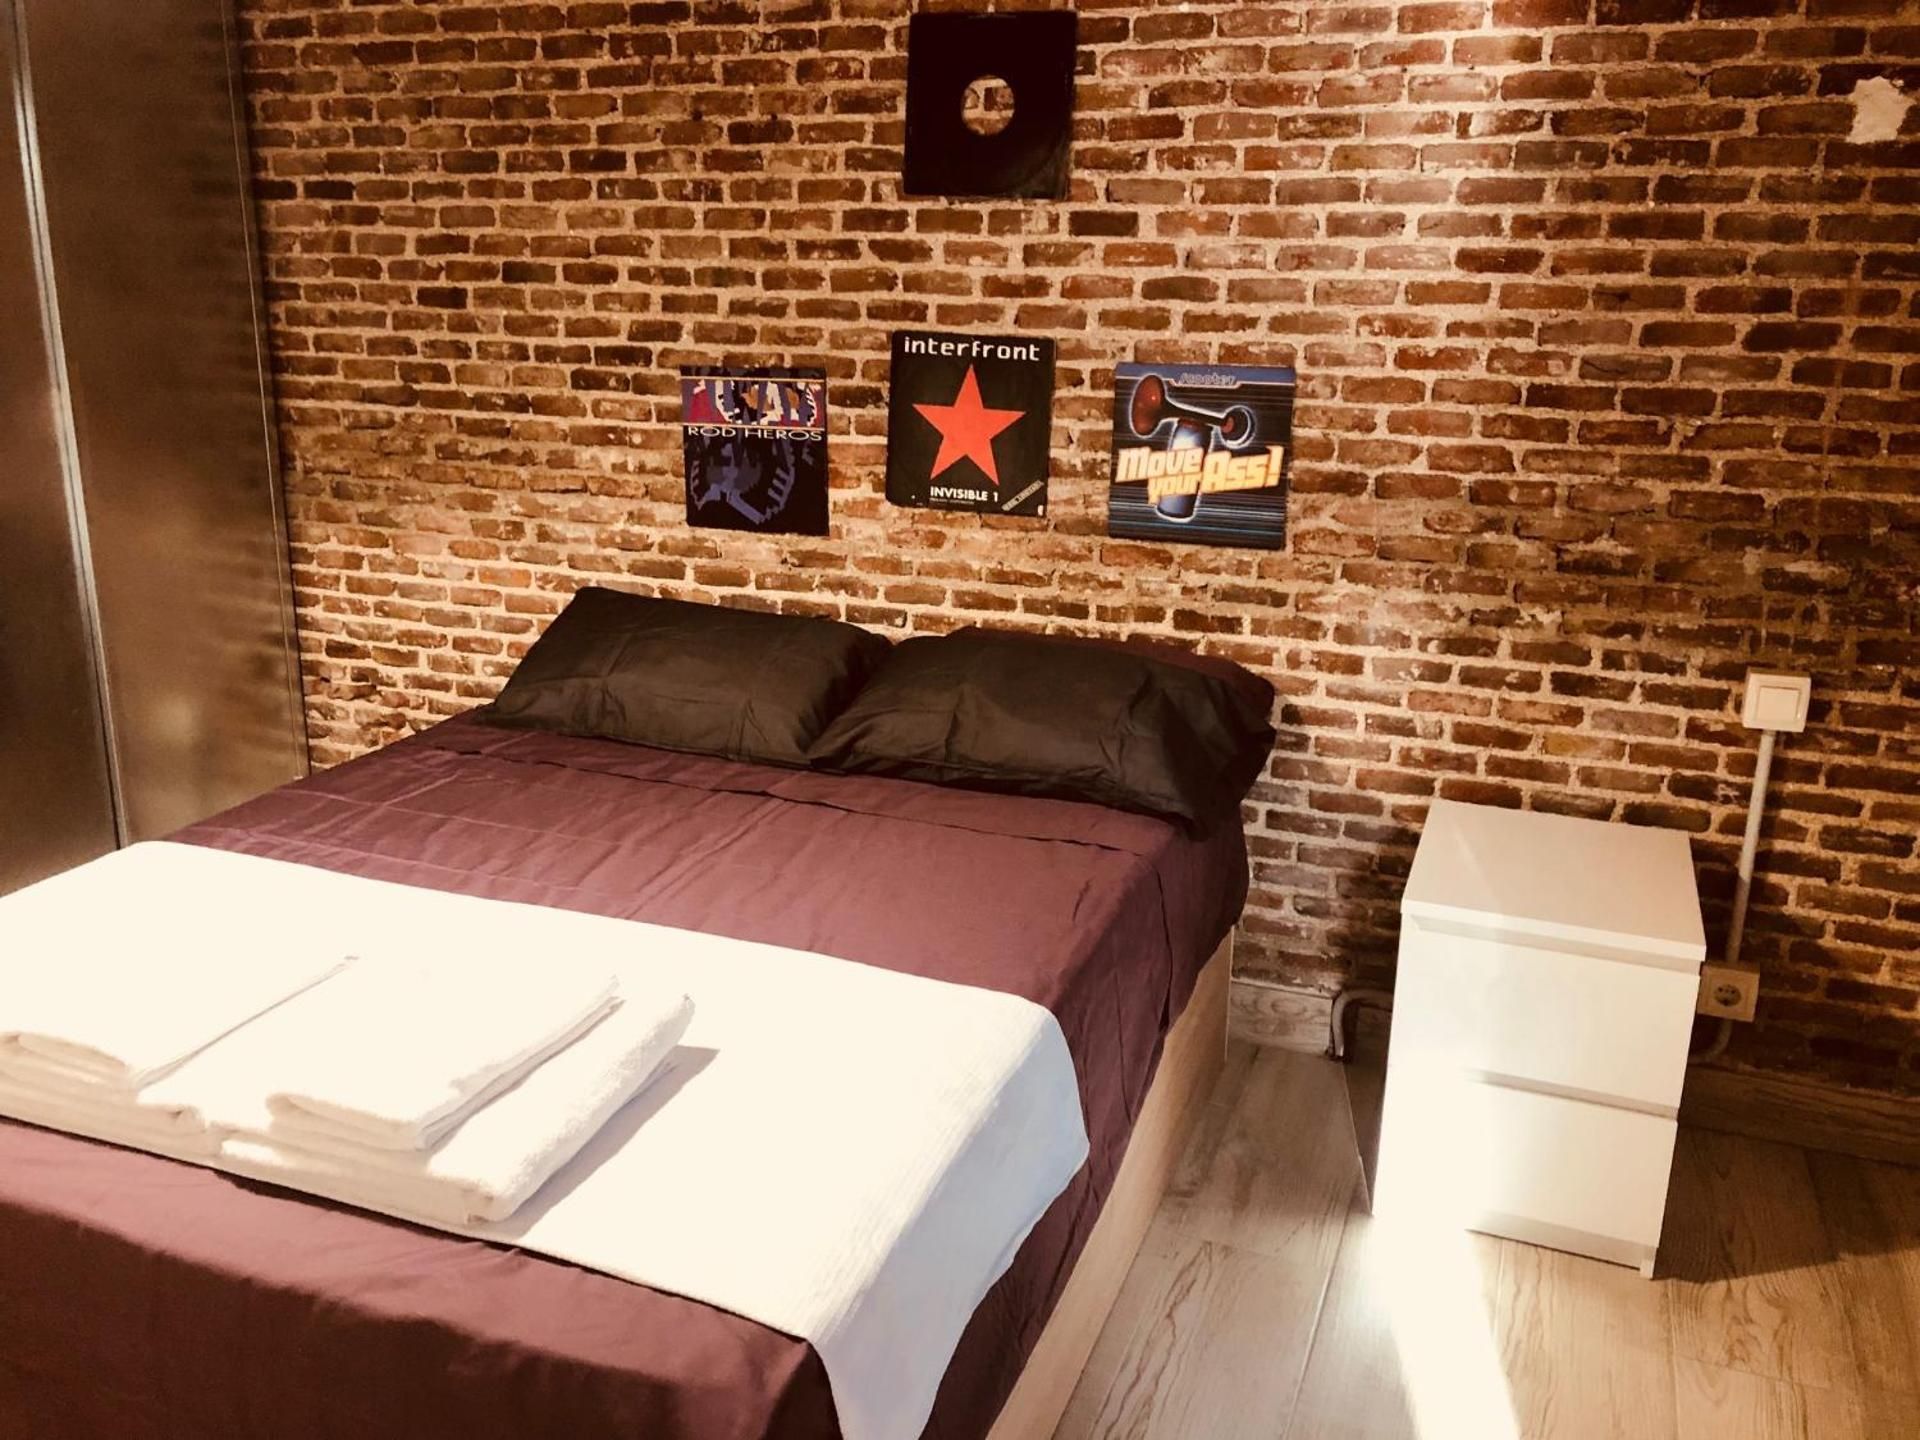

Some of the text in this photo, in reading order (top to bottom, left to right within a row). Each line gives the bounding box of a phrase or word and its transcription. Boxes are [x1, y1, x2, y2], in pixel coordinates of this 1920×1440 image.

[904, 336, 1040, 361] interfront
[688, 426, 822, 441] ROD HEROS
[1115, 446, 1203, 483] Move
[1201, 445, 1284, 494] Ass!
[930, 486, 988, 501] INVISIBLE
[993, 491, 998, 502] 1
